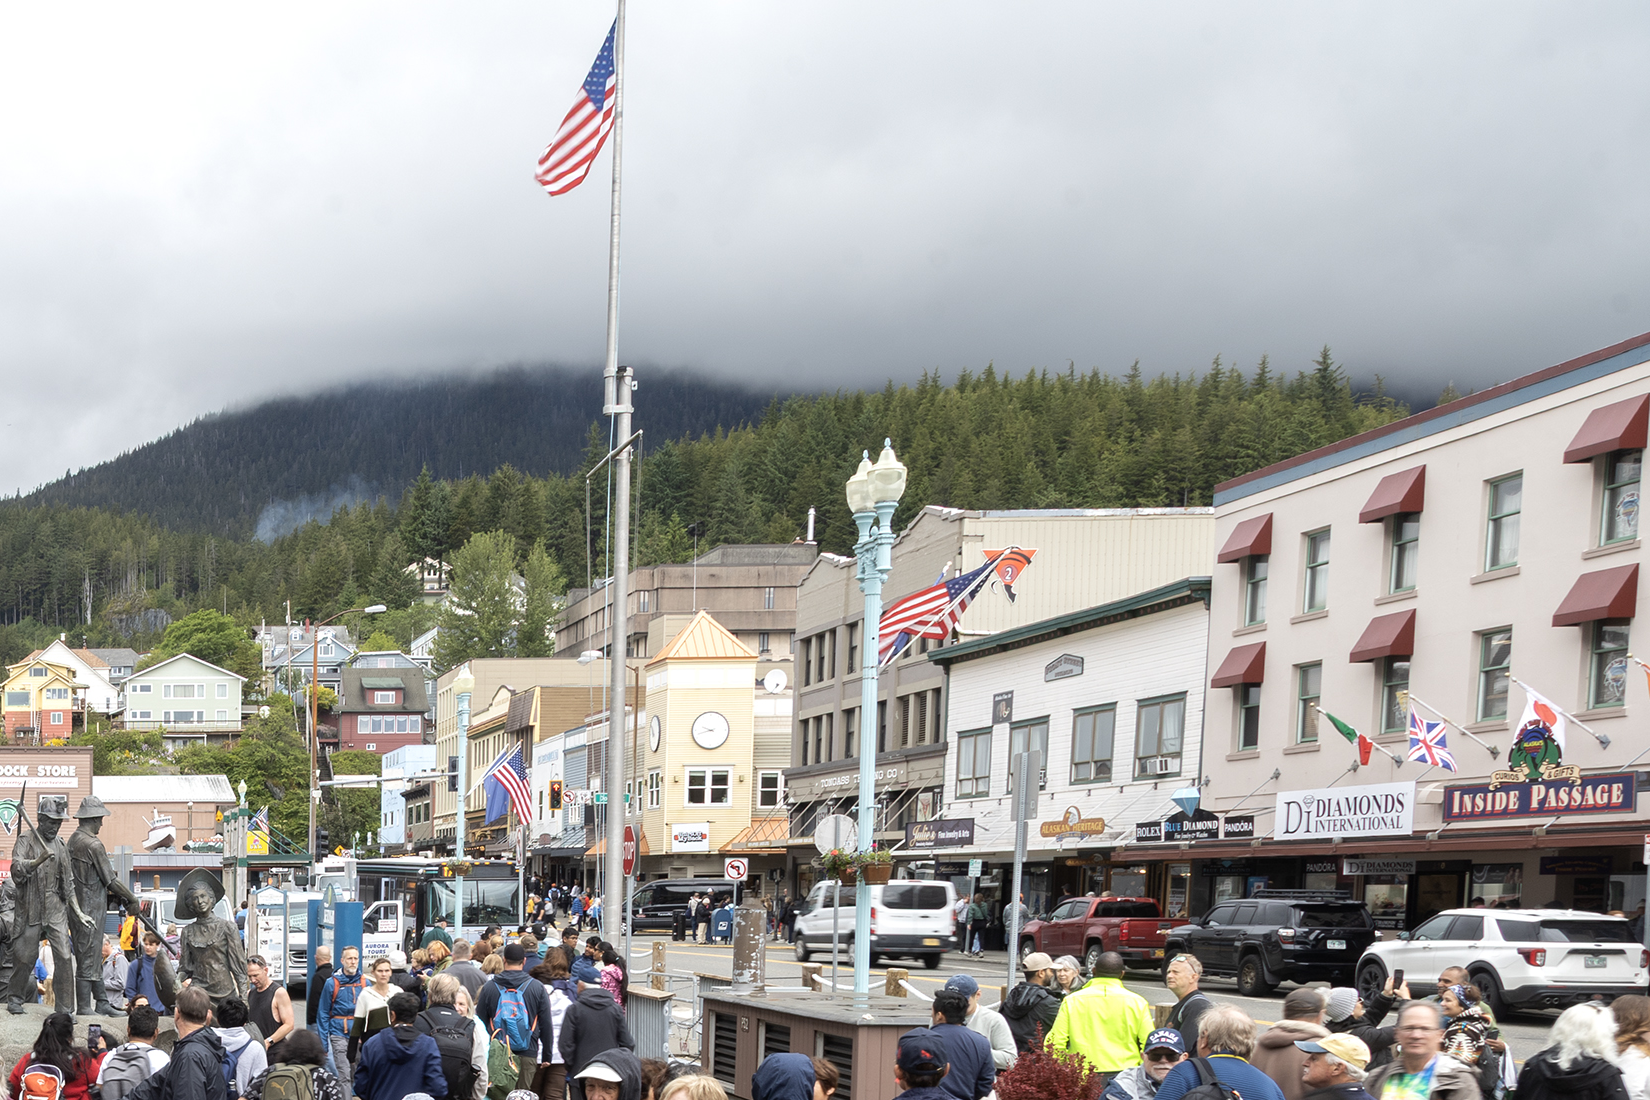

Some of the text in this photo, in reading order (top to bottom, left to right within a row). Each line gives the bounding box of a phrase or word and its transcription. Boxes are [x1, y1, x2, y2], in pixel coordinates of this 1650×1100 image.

[37, 765, 76, 777] STORE
[1495, 767, 1574, 781] CURIOS & GIFTS
[821, 776, 850, 787] TONGASS
[887, 769, 897, 778] CO
[1315, 793, 1405, 818] DIAMONDS
[1452, 783, 1624, 816] INSIDE PASSAGE
[3, 811, 8, 819] 1
[1042, 821, 1103, 834] ALASKAN HERITAGE
[1164, 820, 1218, 831] BLUE DIAMOND
[1315, 816, 1403, 833] INTERNATIONAL
[909, 824, 936, 847] Julie's
[1137, 826, 1161, 838] ROLEX
[1149, 1030, 1179, 1042] CANADA
